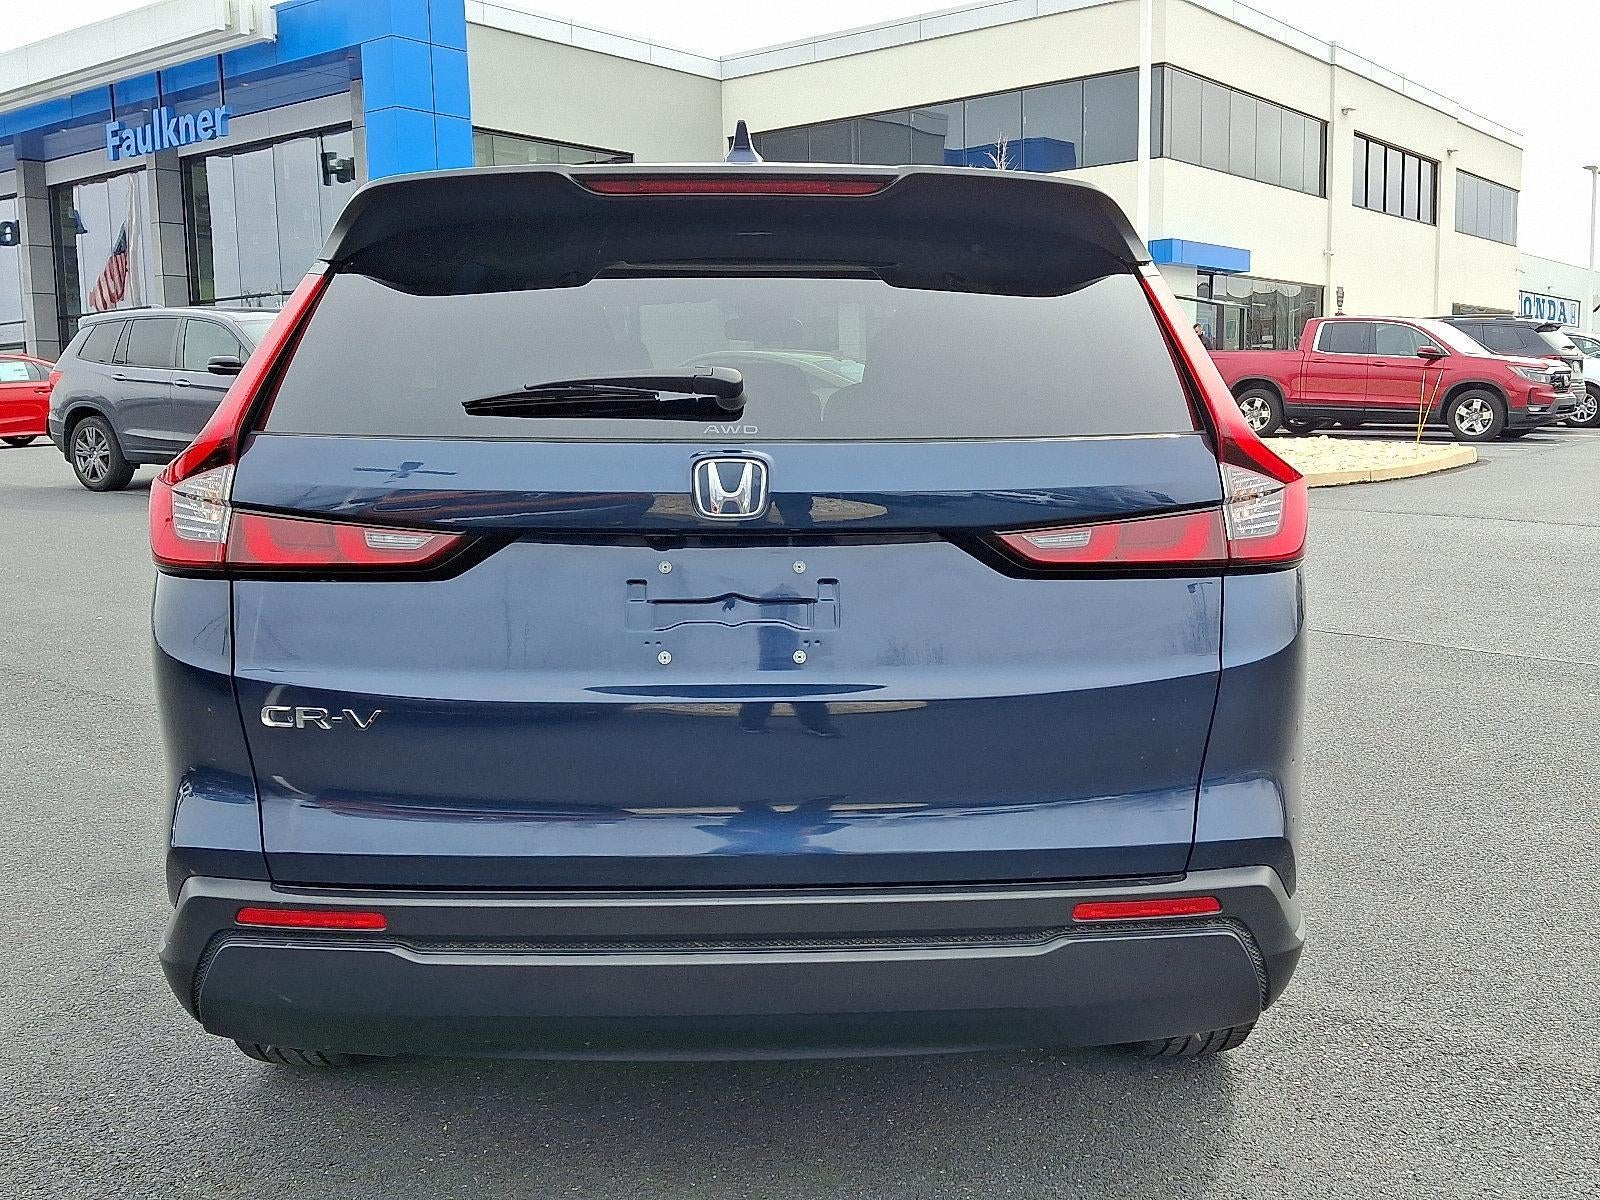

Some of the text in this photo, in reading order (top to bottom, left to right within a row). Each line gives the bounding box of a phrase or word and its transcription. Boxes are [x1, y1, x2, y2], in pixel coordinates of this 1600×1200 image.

[106, 105, 231, 161] Faulkner
[1519, 294, 1568, 323] ONDA
[703, 424, 759, 434] AWD
[260, 705, 382, 731] CR-V
